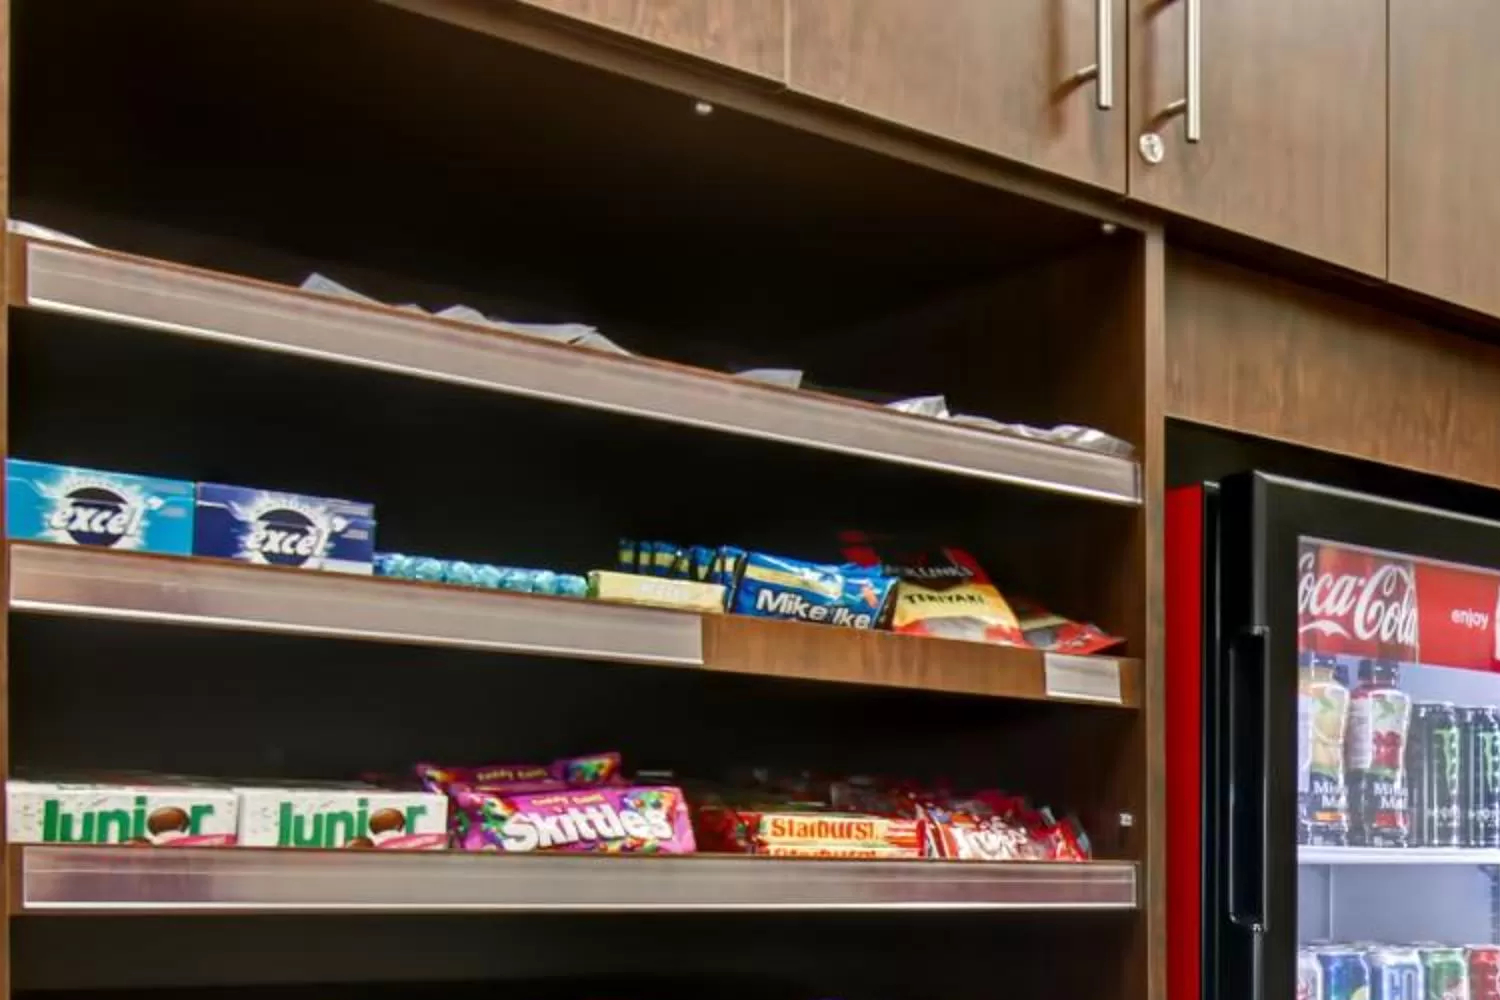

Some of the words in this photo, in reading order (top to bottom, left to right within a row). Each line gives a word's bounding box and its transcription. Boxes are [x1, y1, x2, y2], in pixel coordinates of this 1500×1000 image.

[51, 504, 140, 536] excel
[248, 526, 328, 557] excel
[756, 588, 827, 621] Mike
[834, 605, 871, 630] Ike
[1451, 608, 1489, 631] enjoy
[502, 804, 672, 851] Skittles
[771, 816, 875, 841] Starburst
